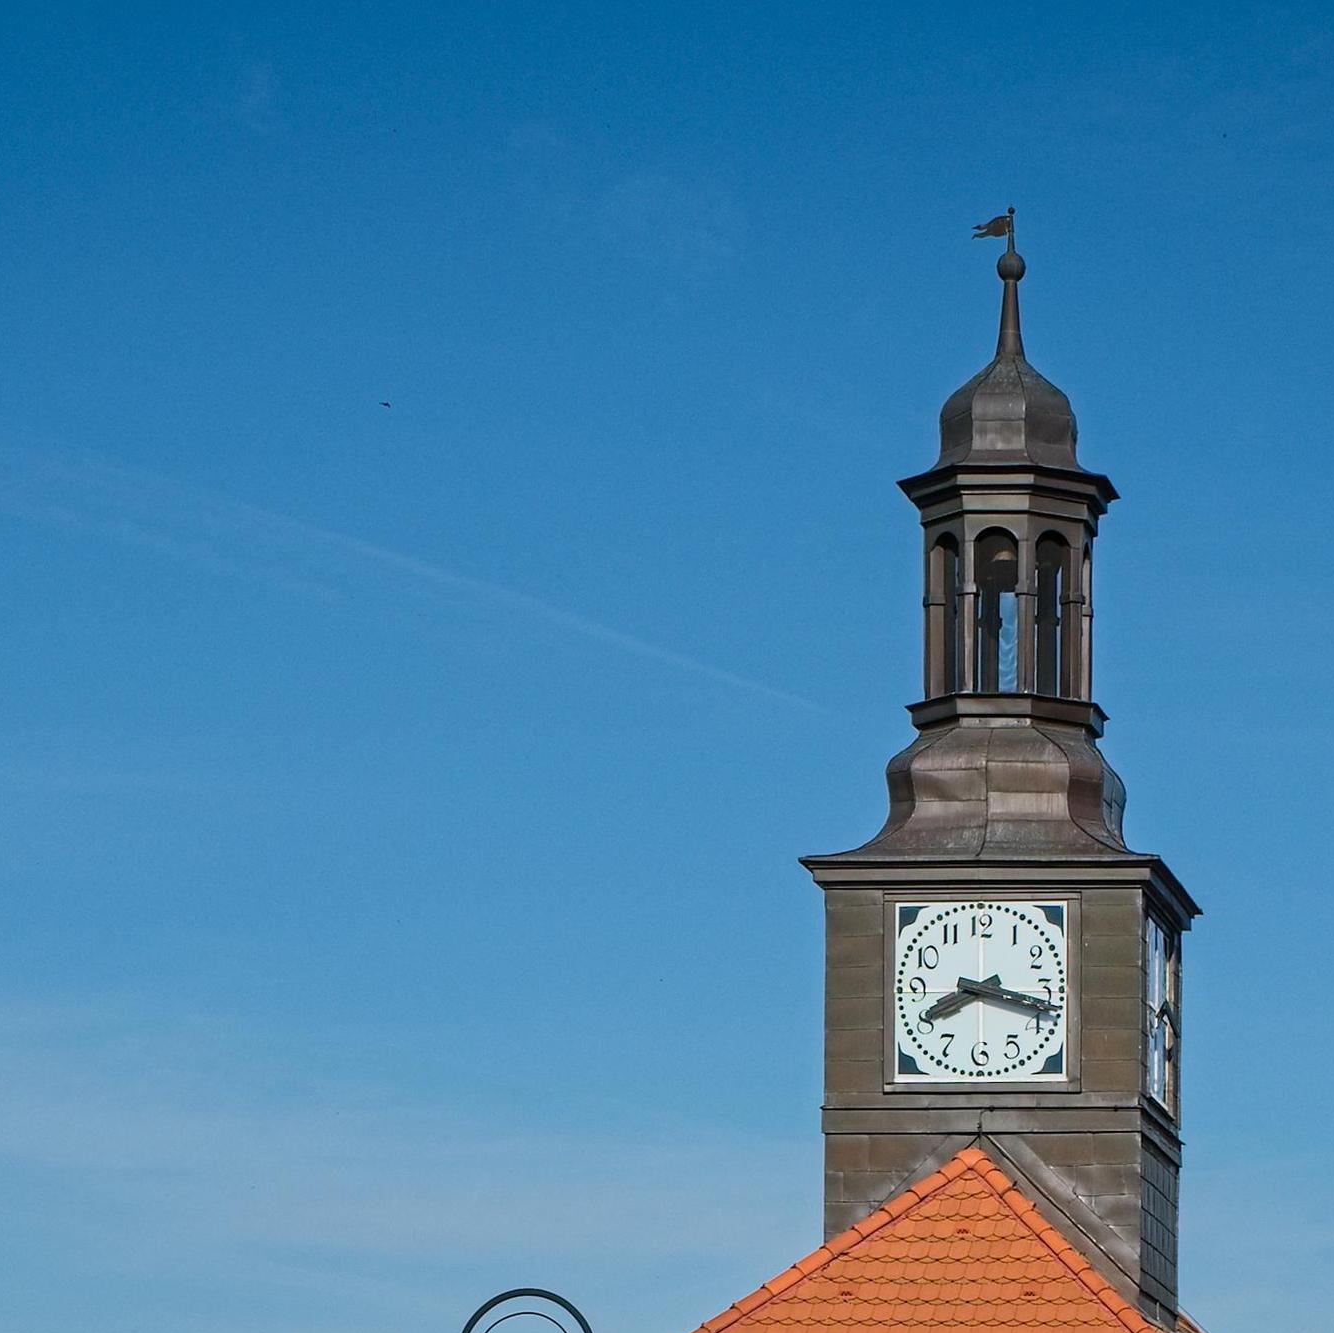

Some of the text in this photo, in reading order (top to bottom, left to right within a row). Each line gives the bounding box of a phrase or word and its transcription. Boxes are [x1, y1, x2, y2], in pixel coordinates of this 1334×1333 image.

[943, 923, 957, 945] 11
[971, 914, 993, 938] 12
[1011, 924, 1017, 946] 1
[917, 945, 939, 969] 10
[1029, 945, 1043, 970] 2
[909, 977, 926, 1002] 9
[1038, 978, 1051, 1005] 3
[917, 1009, 934, 1034] 8
[1025, 1011, 1044, 1035] 4
[940, 1034, 955, 1058] 7
[971, 1042, 989, 1066] 6
[1003, 1034, 1020, 1060] 5
